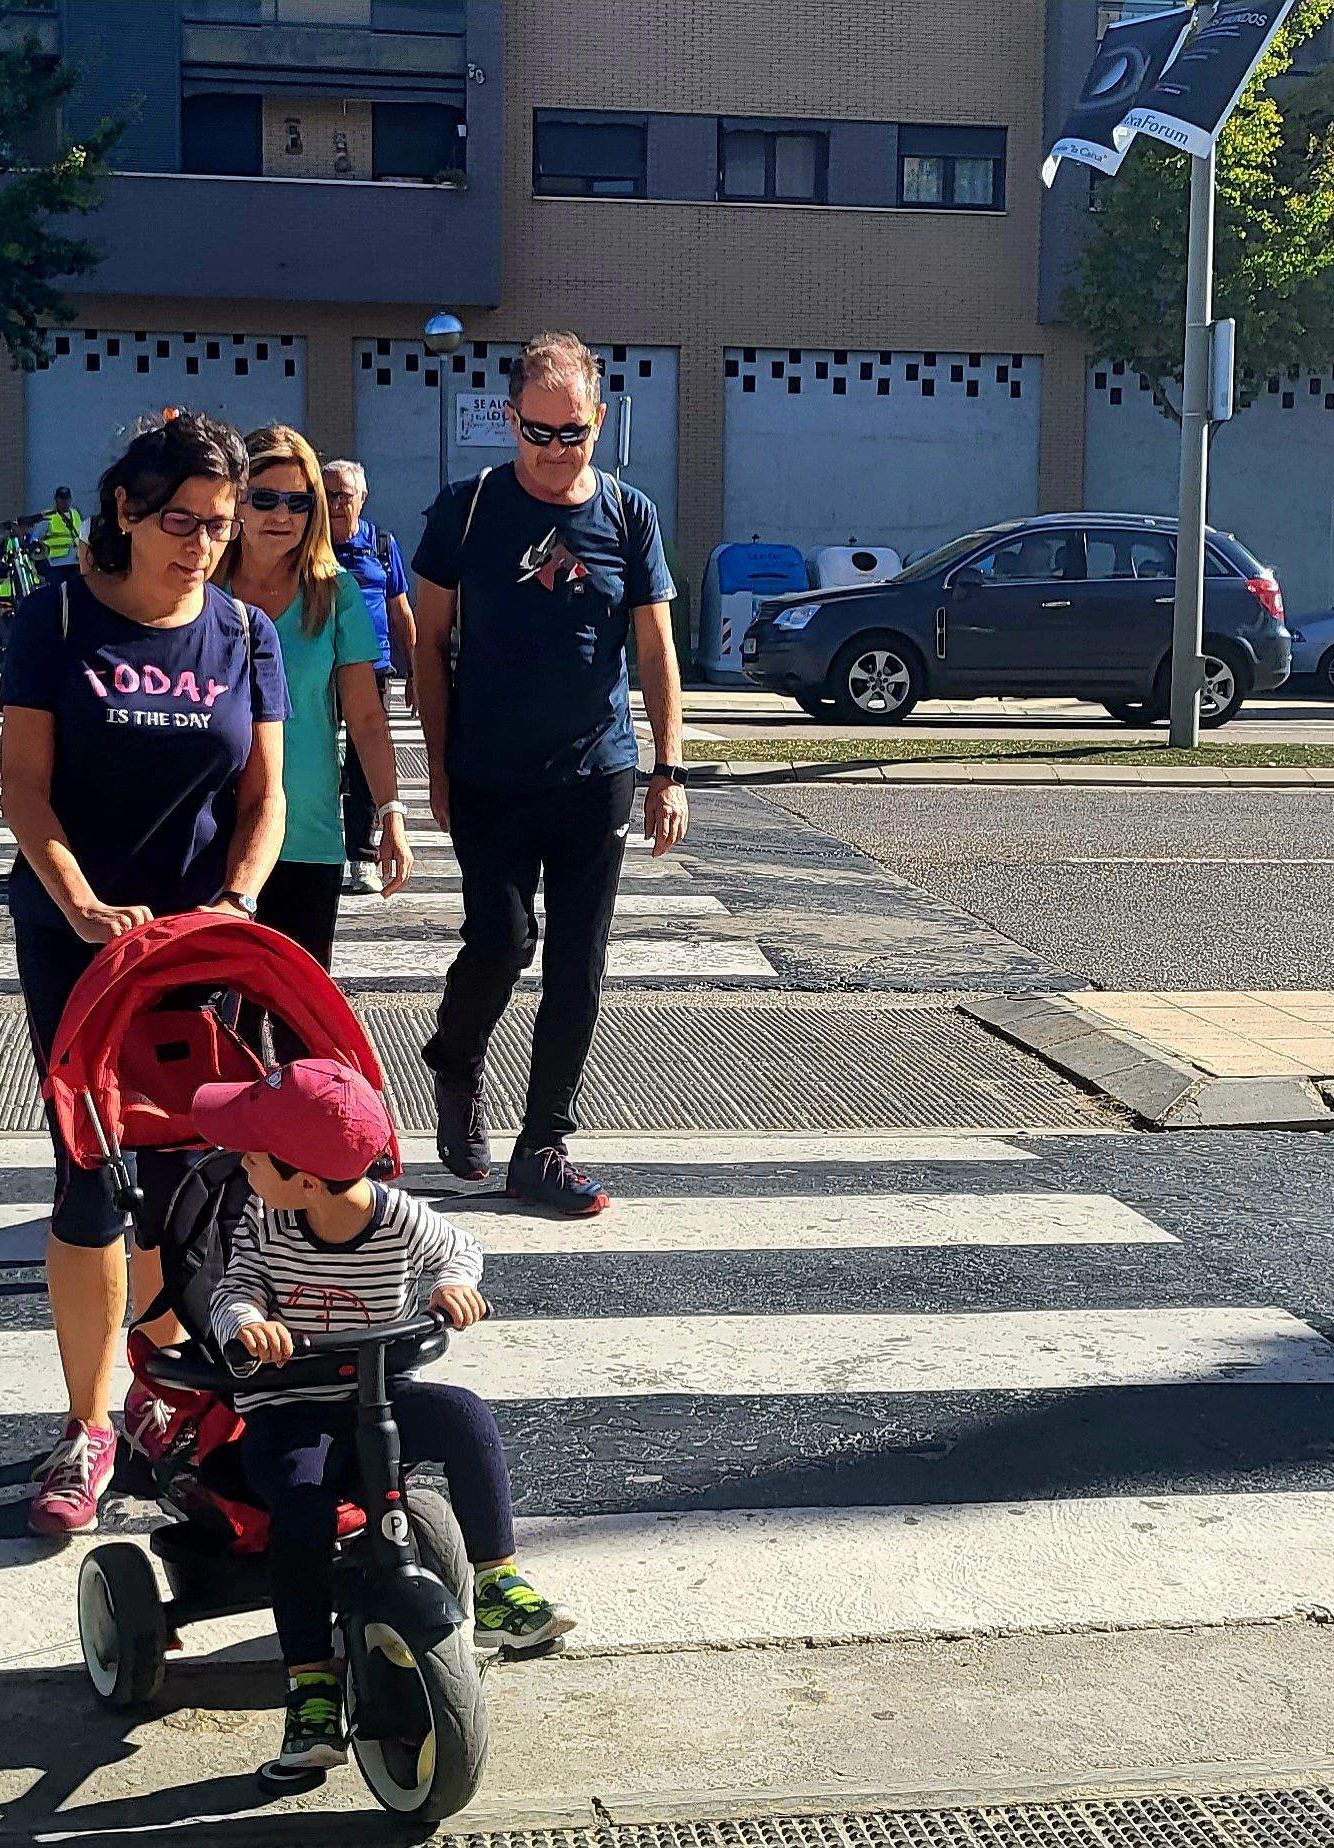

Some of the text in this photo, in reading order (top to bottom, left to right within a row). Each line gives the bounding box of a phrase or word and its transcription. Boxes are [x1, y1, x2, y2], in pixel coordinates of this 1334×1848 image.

[473, 399, 486, 409] SE
[83, 663, 229, 707] TODAY
[106, 708, 212, 729] IS THE DAY
